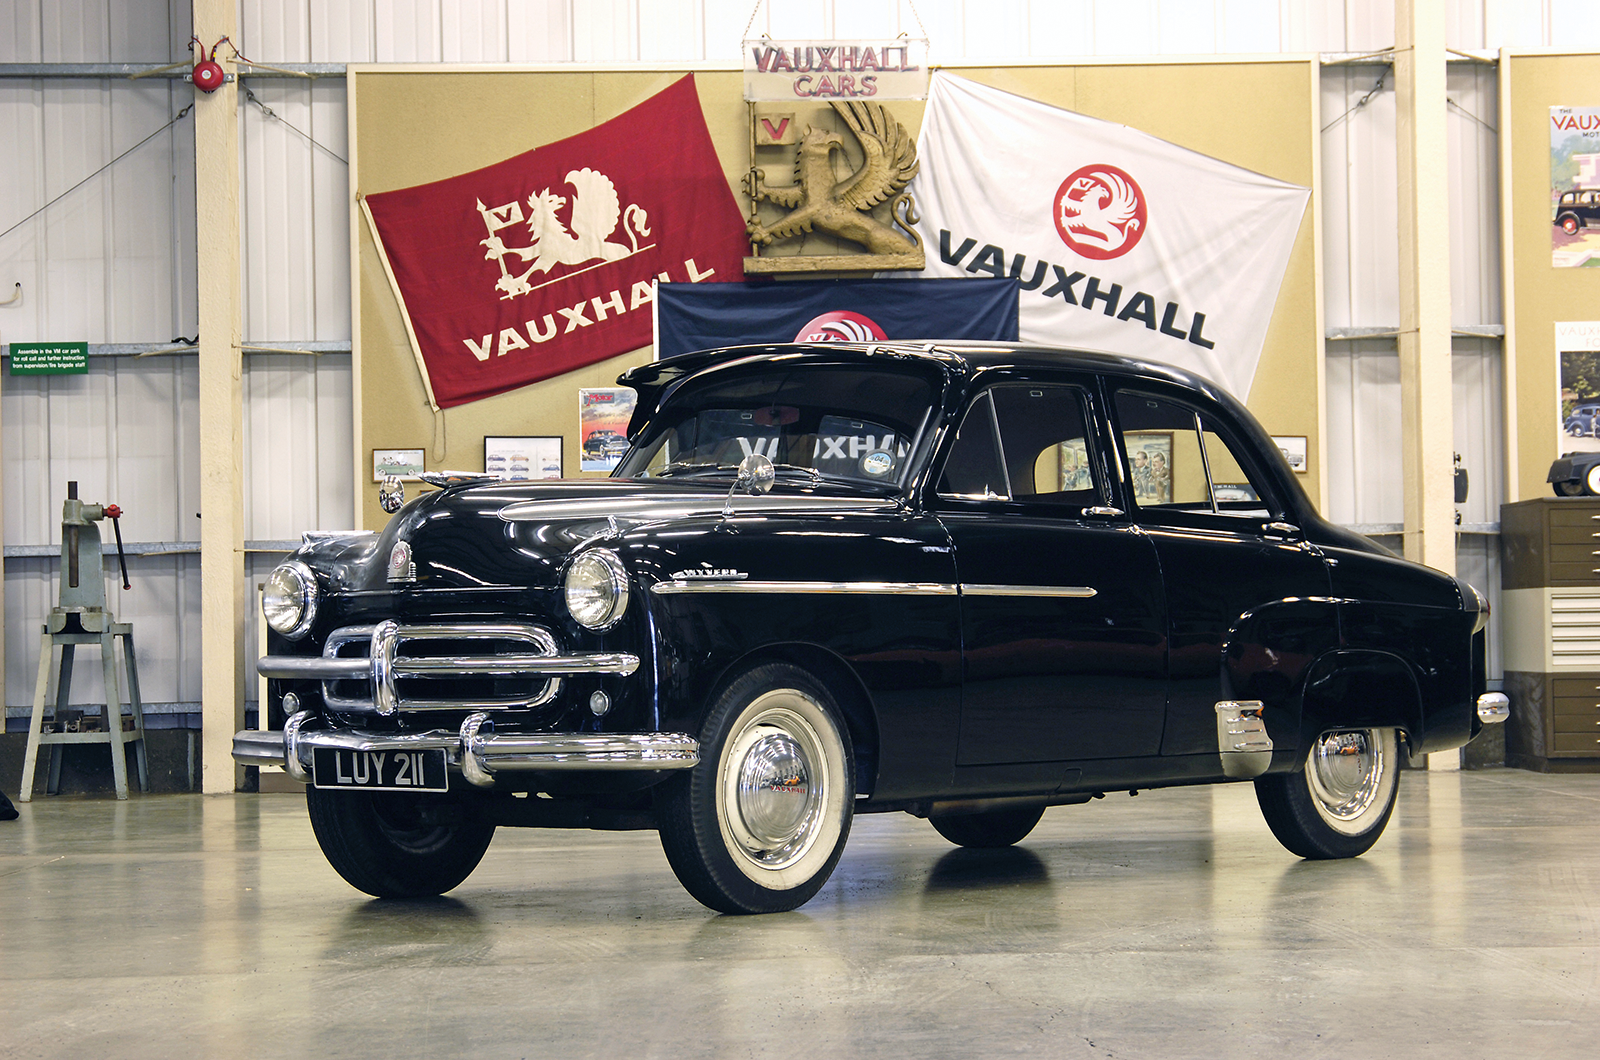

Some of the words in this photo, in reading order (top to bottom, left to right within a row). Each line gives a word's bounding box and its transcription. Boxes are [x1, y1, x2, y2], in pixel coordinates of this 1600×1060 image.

[752, 46, 918, 73] VAUXHALL
[793, 75, 877, 97] CARS
[940, 228, 1215, 350] VAUXHALL
[335, 750, 386, 785] LUY
[393, 752, 425, 786] 211
